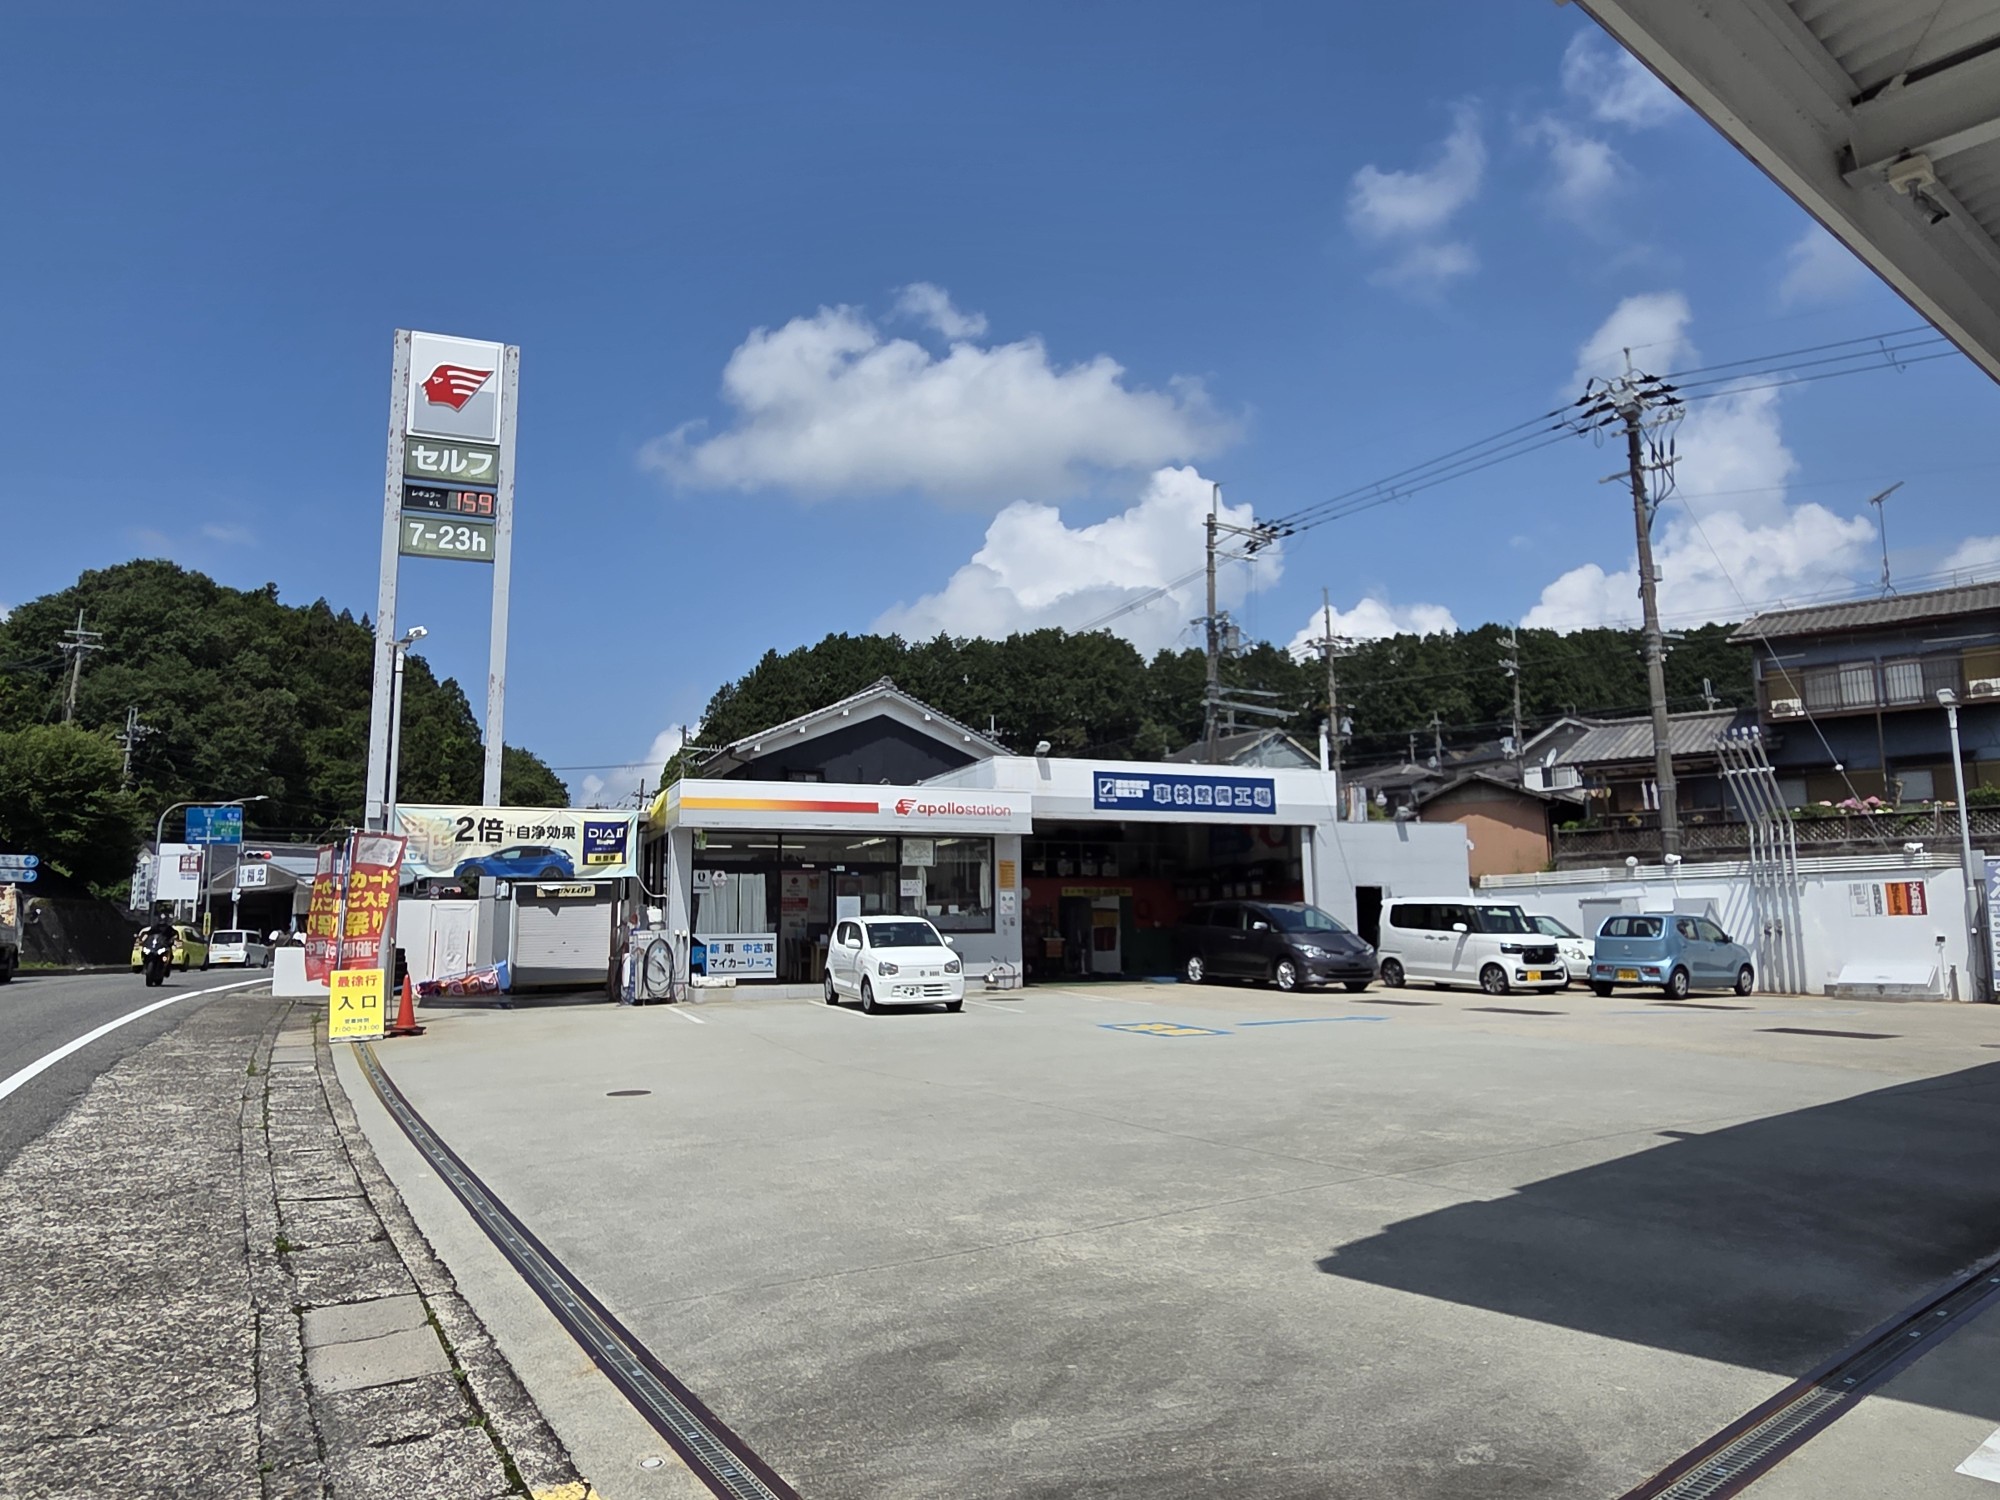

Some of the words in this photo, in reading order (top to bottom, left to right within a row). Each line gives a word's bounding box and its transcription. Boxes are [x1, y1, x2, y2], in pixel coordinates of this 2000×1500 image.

[412, 444, 493, 476] セルフ
[411, 489, 441, 499] レギュラー
[457, 492, 493, 515] 159
[409, 522, 487, 552] 7-23h
[1153, 783, 1272, 808] 車検整備工場
[917, 801, 1012, 818] apollostation
[350, 868, 397, 889] カード
[346, 910, 384, 937] 祭り
[709, 957, 774, 968] マイカーリース
[337, 974, 378, 988] 最徐行
[338, 995, 377, 1011] 入口
